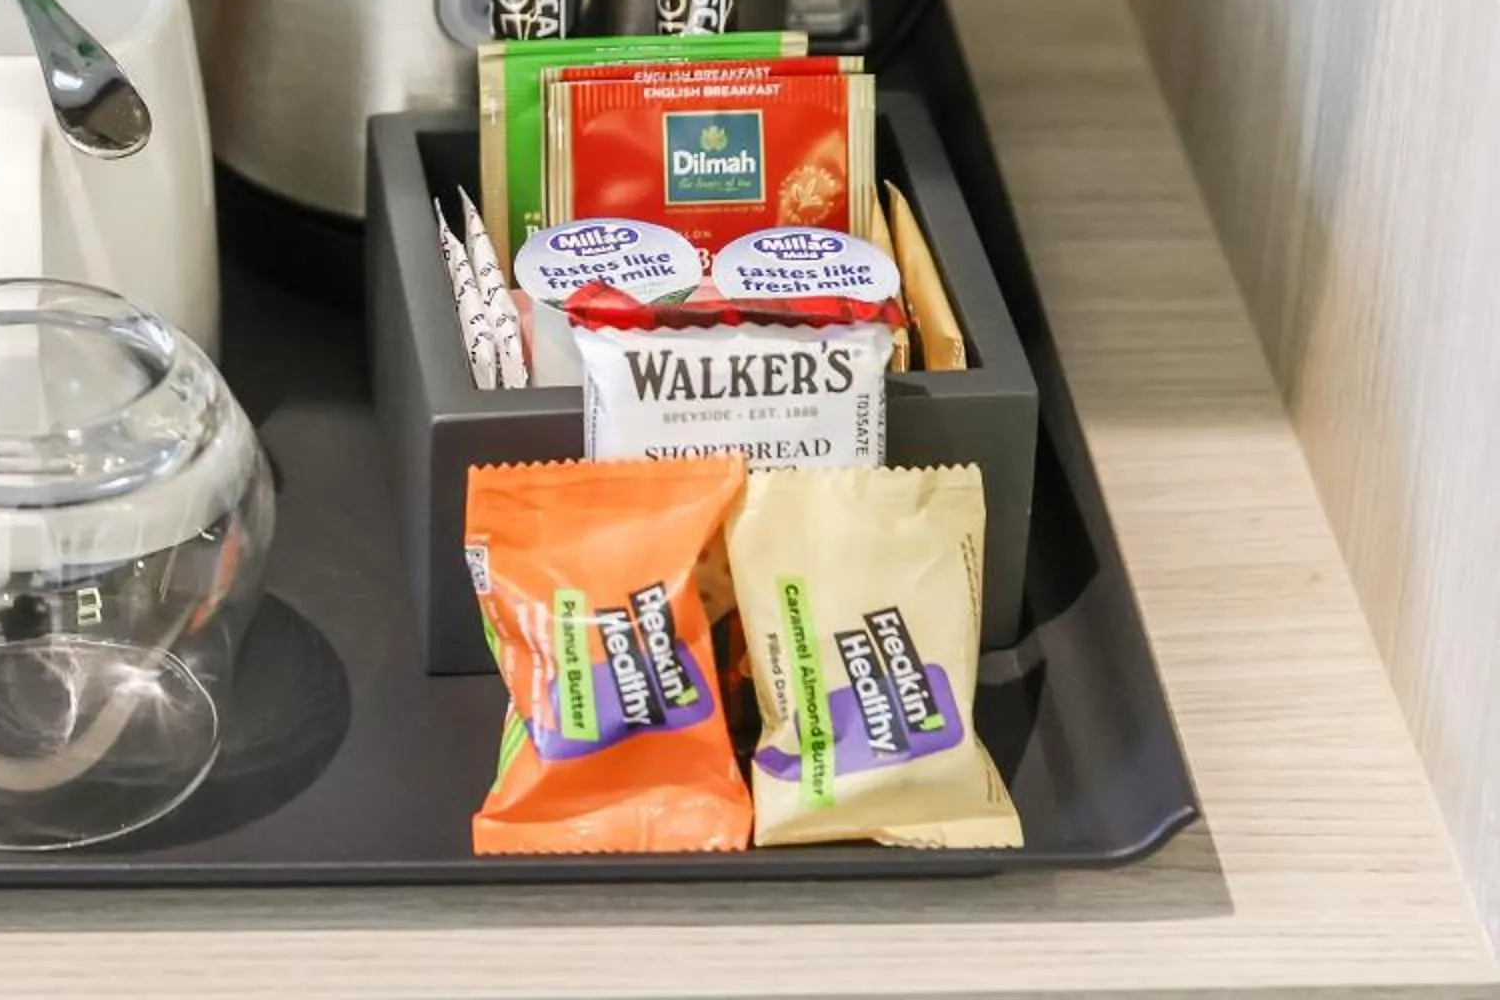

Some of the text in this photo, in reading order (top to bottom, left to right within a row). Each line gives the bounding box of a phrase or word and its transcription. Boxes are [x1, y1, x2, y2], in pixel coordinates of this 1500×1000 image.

[633, 66, 772, 83] ENGLISH BREAKFAST
[642, 84, 781, 99] ENGLISH BREAKFAST
[672, 149, 757, 176] Dilmah
[558, 229, 631, 249] Millac
[761, 235, 836, 252] Millac
[539, 251, 671, 277] tastes like
[621, 264, 676, 283] milk
[736, 263, 871, 280] tastes like
[742, 276, 874, 292] fresh milk
[624, 340, 853, 402] WALKER'S
[662, 410, 735, 425] SPEYSIDE
[645, 437, 832, 461] SHORTBREAD
[600, 610, 652, 725] Healthy
[567, 669, 585, 729] Butter
[785, 583, 828, 797] Caramel Almond Butter
[840, 633, 898, 753] Healthy
